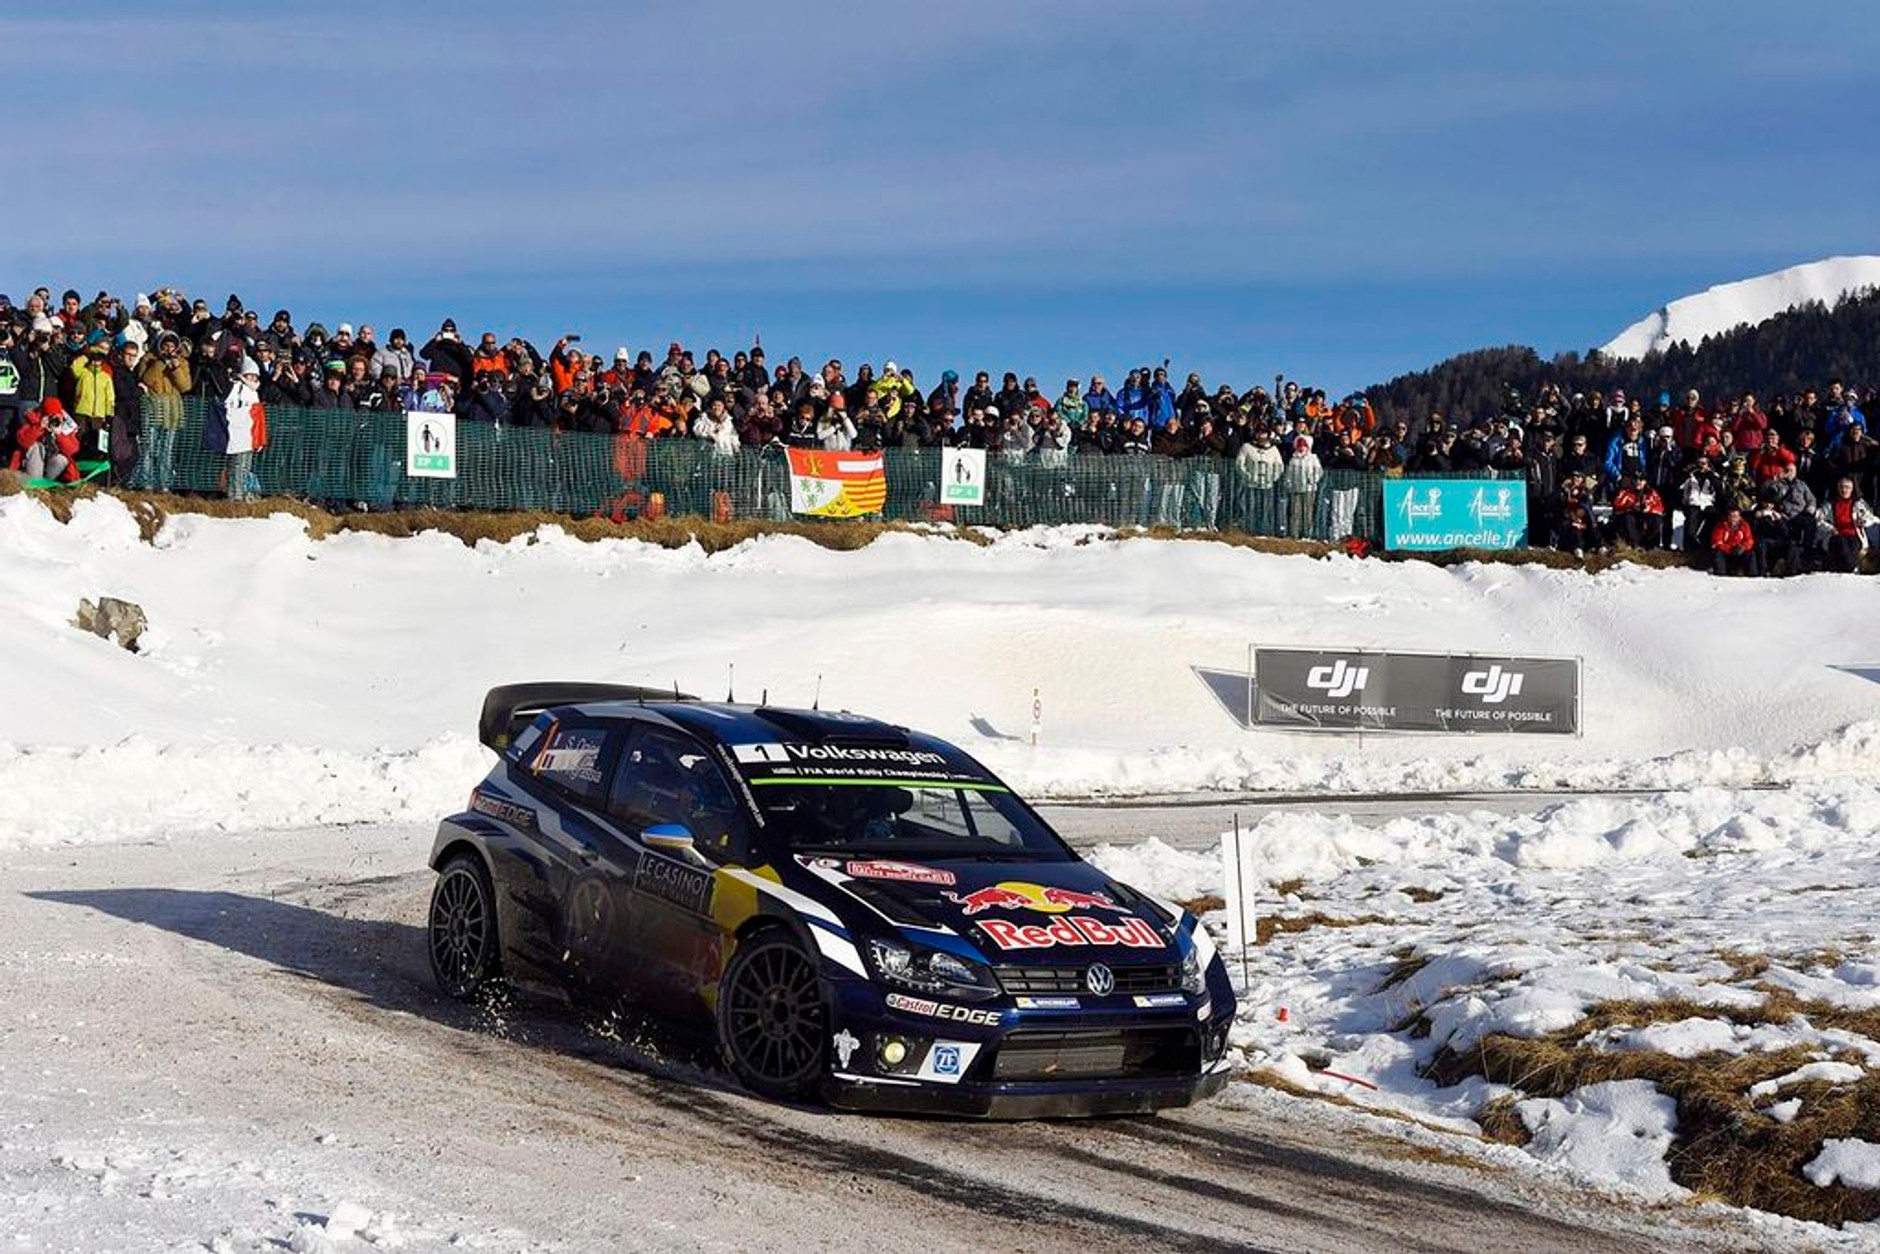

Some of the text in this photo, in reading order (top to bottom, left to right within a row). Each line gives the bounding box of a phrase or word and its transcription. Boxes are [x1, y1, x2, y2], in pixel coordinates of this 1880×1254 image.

[1395, 529, 1523, 549] www.ancelle.fr
[1300, 704, 1335, 715] FUTURE
[1338, 705, 1350, 715] OF
[1353, 705, 1397, 717] POSSIBLE
[1435, 708, 1552, 722] THE FUTURE OF POSSIBLE
[755, 744, 948, 765] 1 Volkswagen
[975, 914, 1167, 950] Red Bull
[896, 996, 1003, 1027] Castrol EDGE
[940, 1052, 957, 1067] ZF
